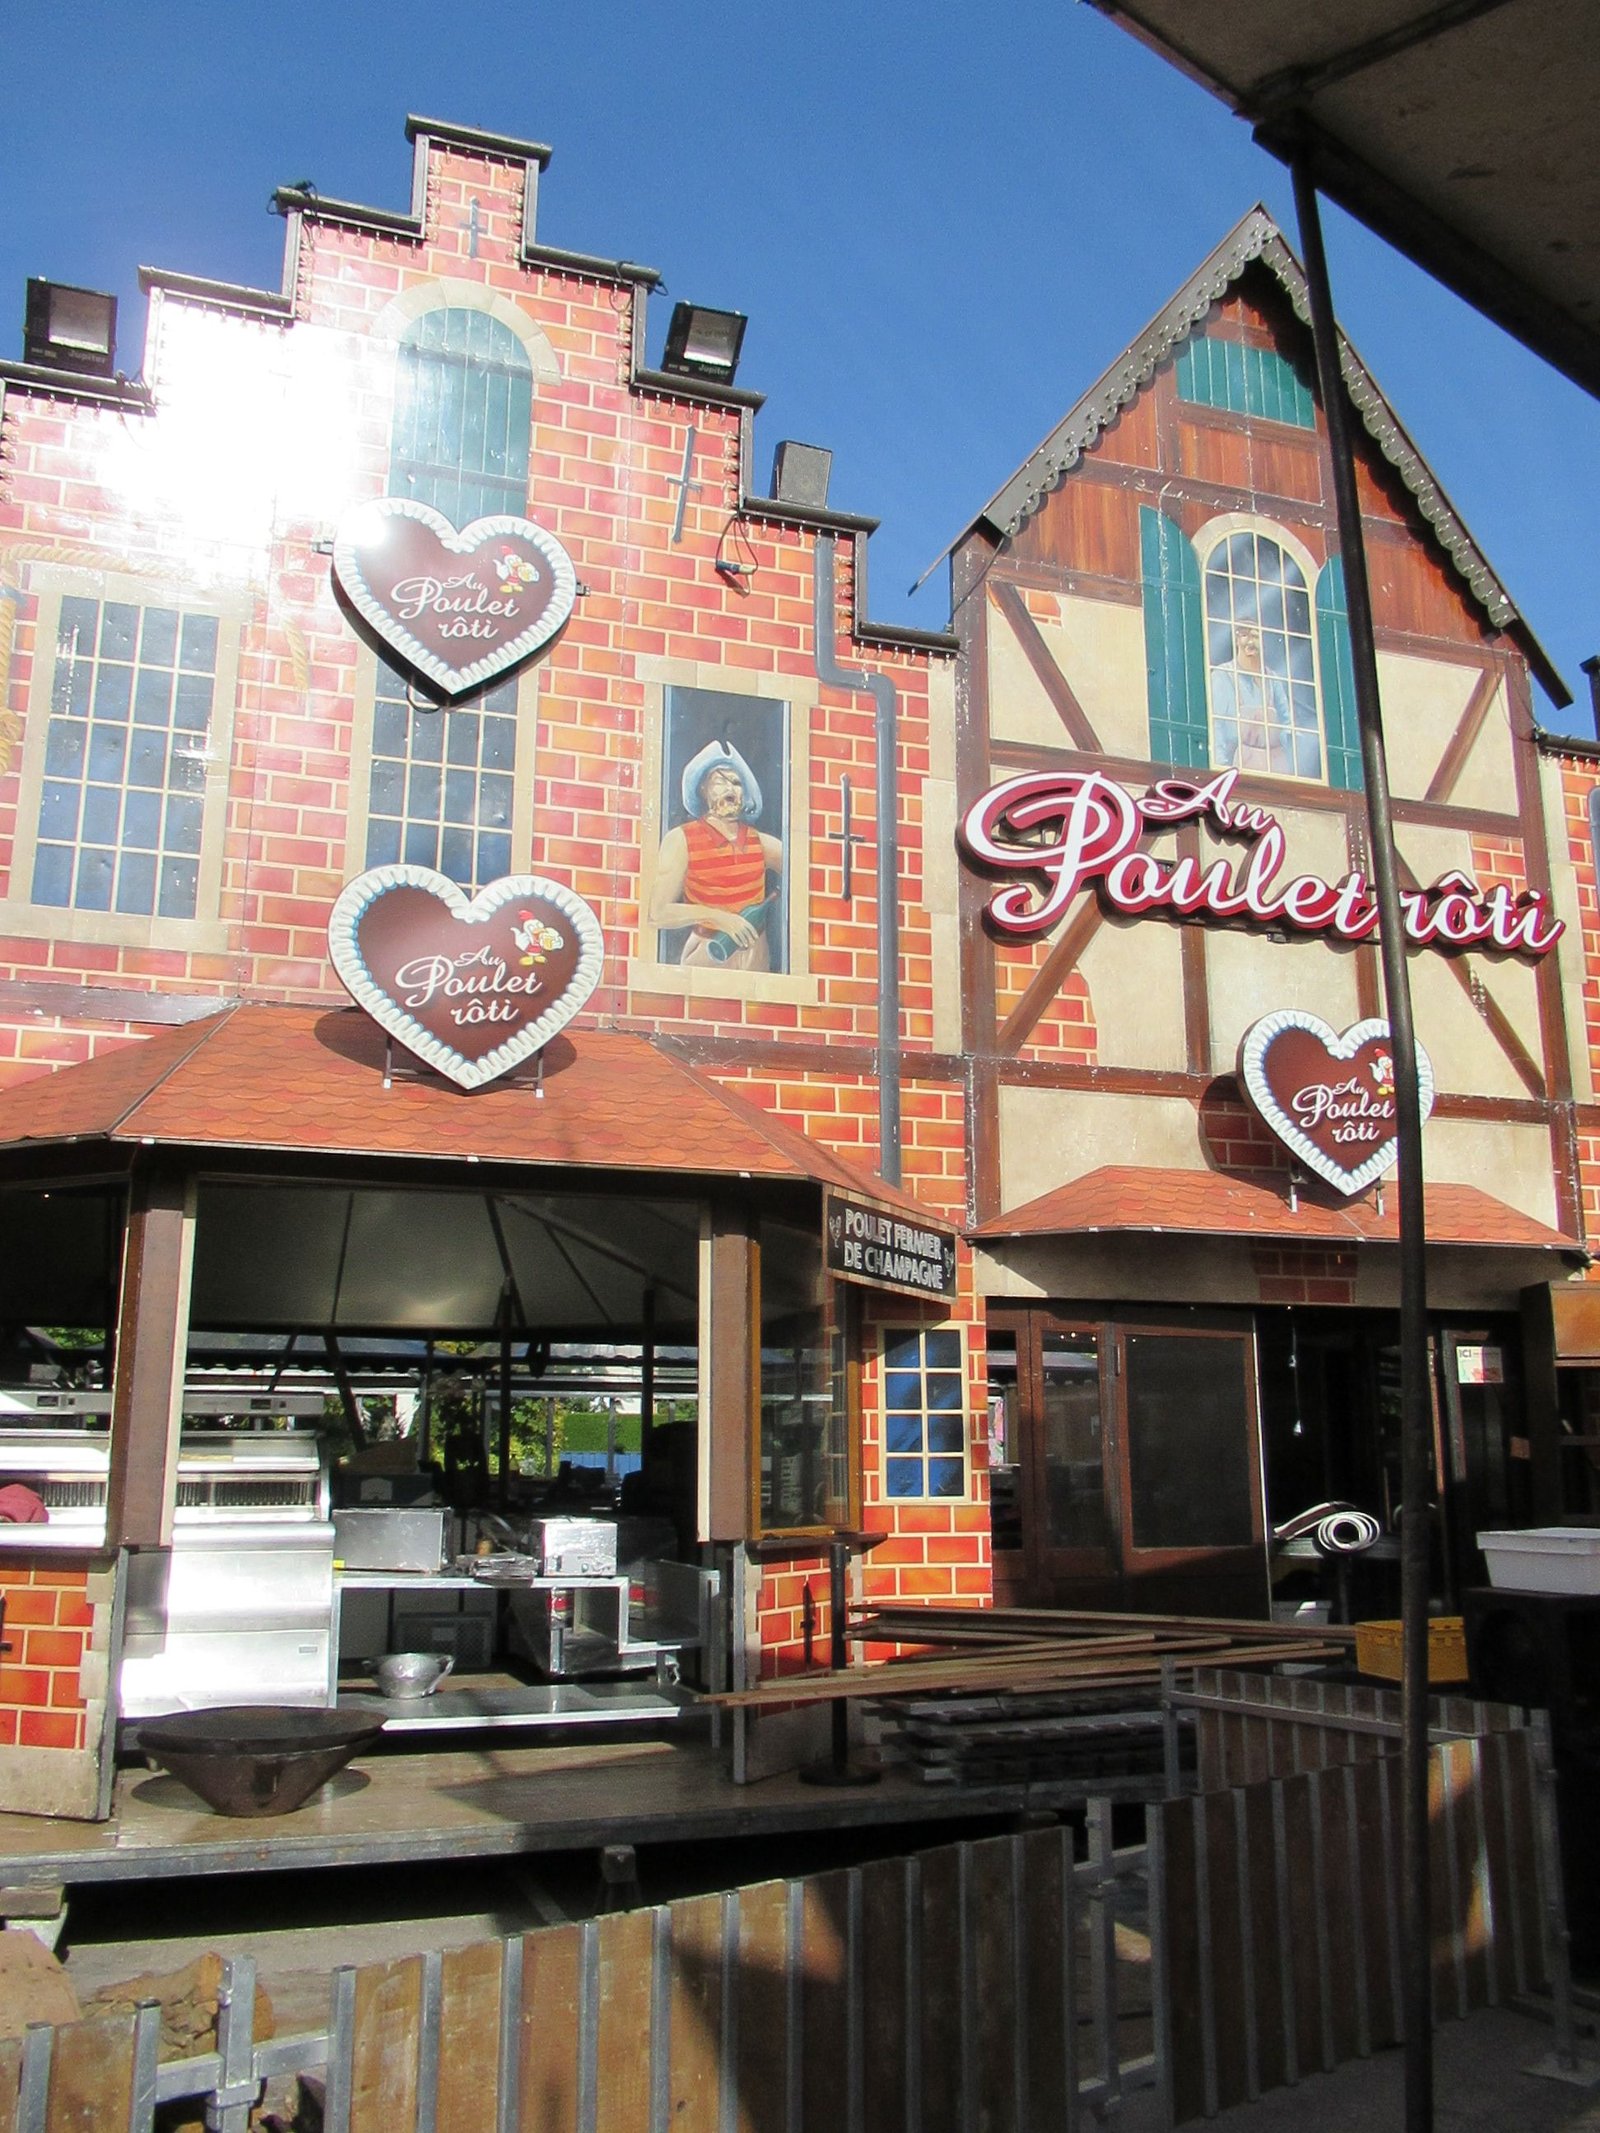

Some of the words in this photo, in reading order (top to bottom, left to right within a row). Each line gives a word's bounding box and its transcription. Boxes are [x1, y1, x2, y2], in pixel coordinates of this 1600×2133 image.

[391, 576, 520, 619] Poulet
[442, 572, 488, 591] Au
[438, 616, 499, 639] rôti
[1134, 767, 1277, 833] Au
[962, 769, 1379, 934] Poulet
[1398, 868, 1567, 950] rôti
[453, 944, 504, 967] Au
[394, 954, 543, 1008] Poulet
[450, 998, 519, 1026] rôti
[1291, 1083, 1396, 1128] Poulet
[1332, 1077, 1367, 1095] Au
[1331, 1121, 1380, 1143] rôti
[844, 1207, 892, 1247] POULET
[893, 1222, 942, 1261] FERMIER
[843, 1240, 863, 1270] DE
[864, 1246, 944, 1290] CHAMPAGNE
